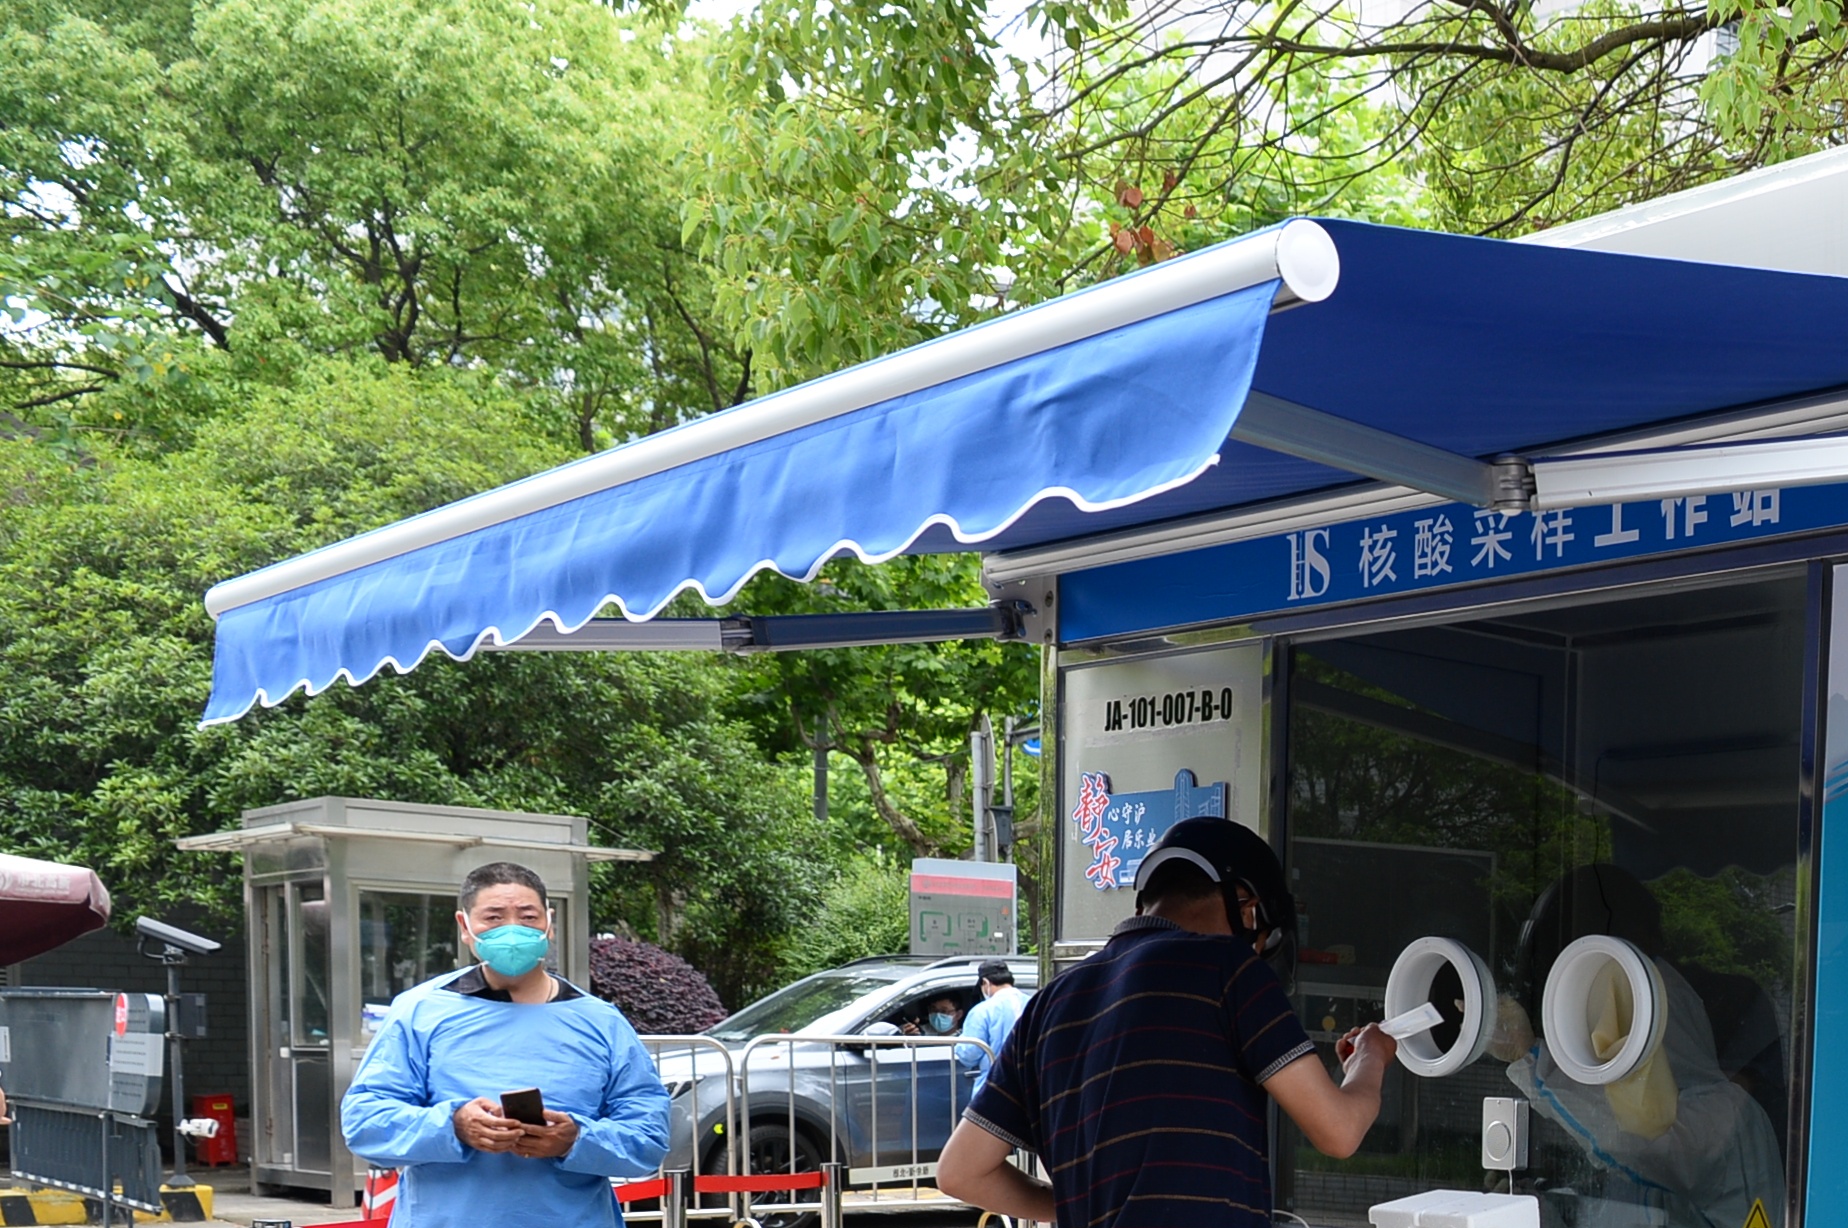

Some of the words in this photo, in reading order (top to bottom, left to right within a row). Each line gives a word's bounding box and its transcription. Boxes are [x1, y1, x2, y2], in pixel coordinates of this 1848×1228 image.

[1358, 487, 1782, 590] 核酸采样工作站
[1104, 687, 1233, 731] JA-101-007-B-0
